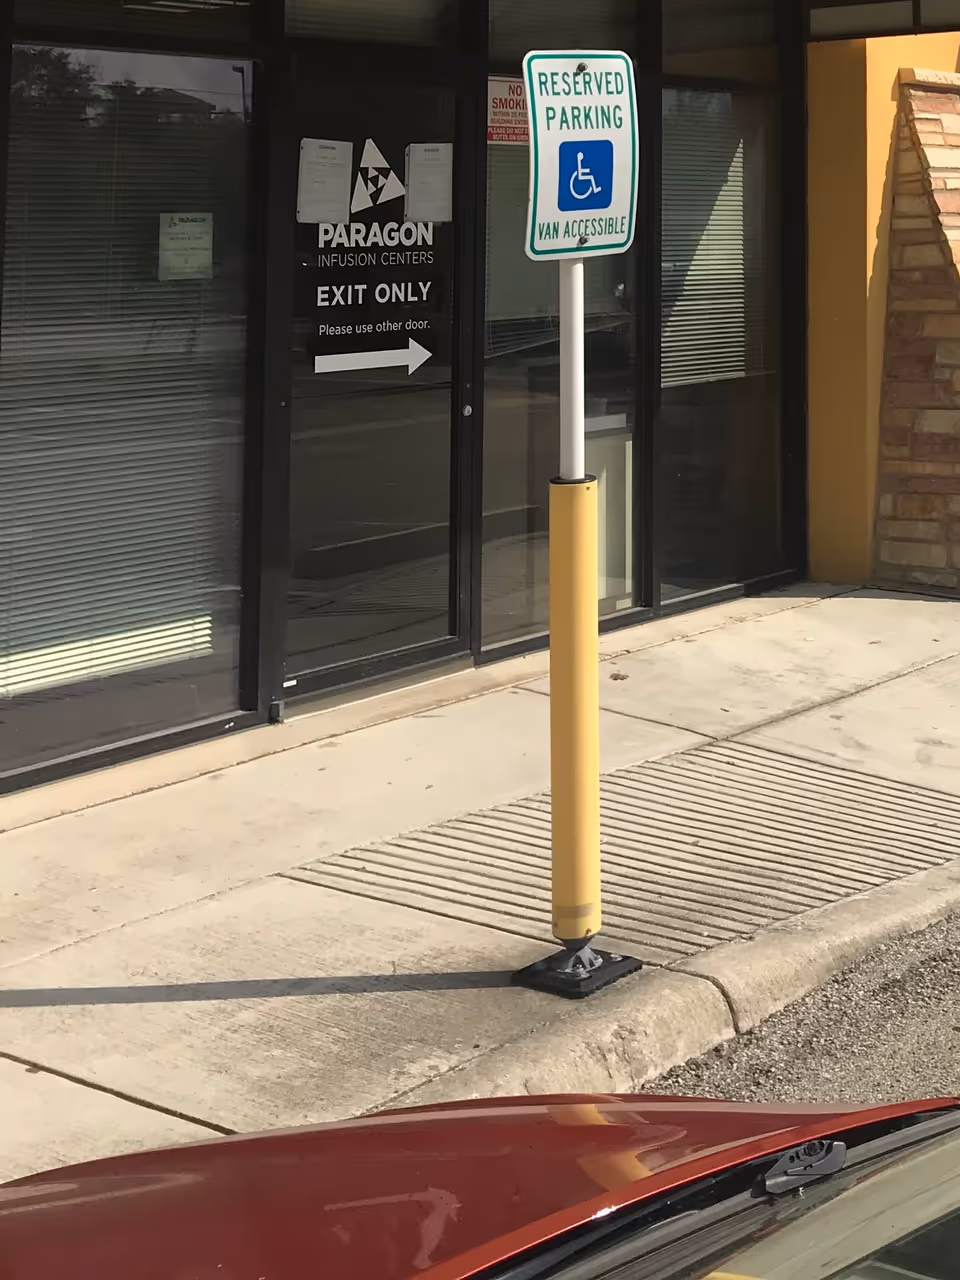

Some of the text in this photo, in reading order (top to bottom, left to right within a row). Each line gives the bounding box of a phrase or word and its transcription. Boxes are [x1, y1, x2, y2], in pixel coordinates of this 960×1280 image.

[508, 84, 523, 97] NO
[538, 71, 624, 96] RESERVED
[545, 105, 623, 131] PARKING
[318, 221, 433, 248] PARAGON
[538, 216, 626, 241] VAN ACCESSIBLE
[318, 251, 434, 268] INFUSION CENTERS
[317, 281, 432, 306] EXIT ONLY
[319, 319, 431, 336] Please use other door.
